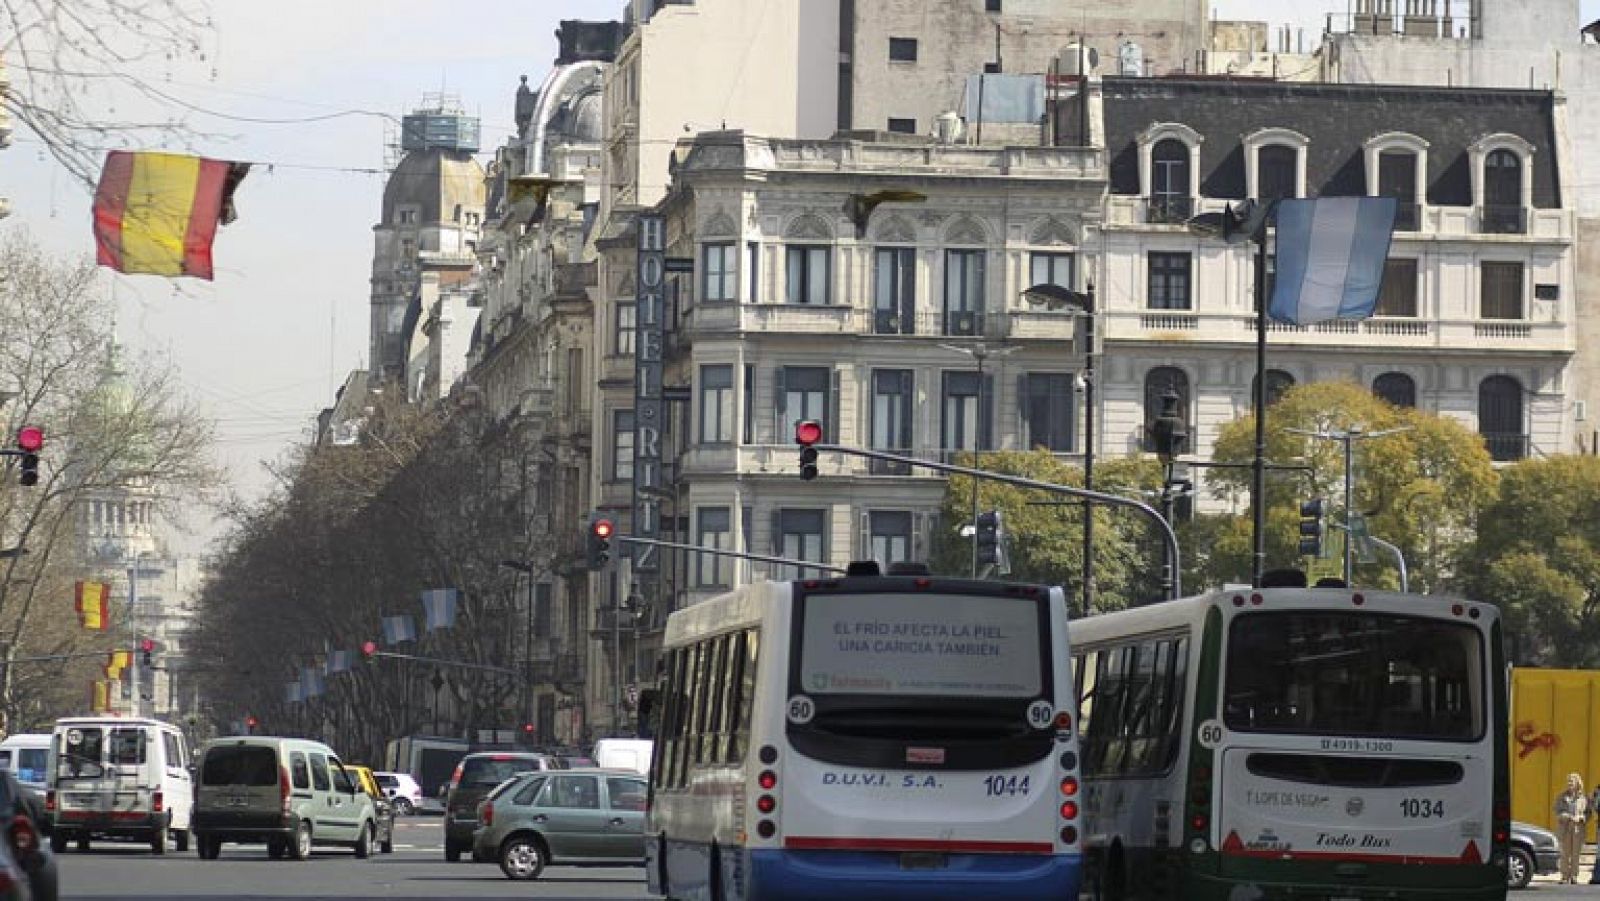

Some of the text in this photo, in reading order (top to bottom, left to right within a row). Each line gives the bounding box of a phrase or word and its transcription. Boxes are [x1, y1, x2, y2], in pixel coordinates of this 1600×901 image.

[636, 218, 662, 568] HOTEL RITZ
[833, 620, 851, 635] EL
[893, 622, 947, 638] AFECTA
[951, 624, 970, 638] LA
[838, 639, 874, 652] UNA
[874, 640, 933, 654] CARICIA
[1032, 705, 1051, 723] 90
[1202, 726, 1222, 743] 60
[902, 774, 944, 788] S.A.
[983, 775, 1030, 796] 1044
[1400, 798, 1444, 818] 1034
[1316, 832, 1392, 848] Todo Bus
